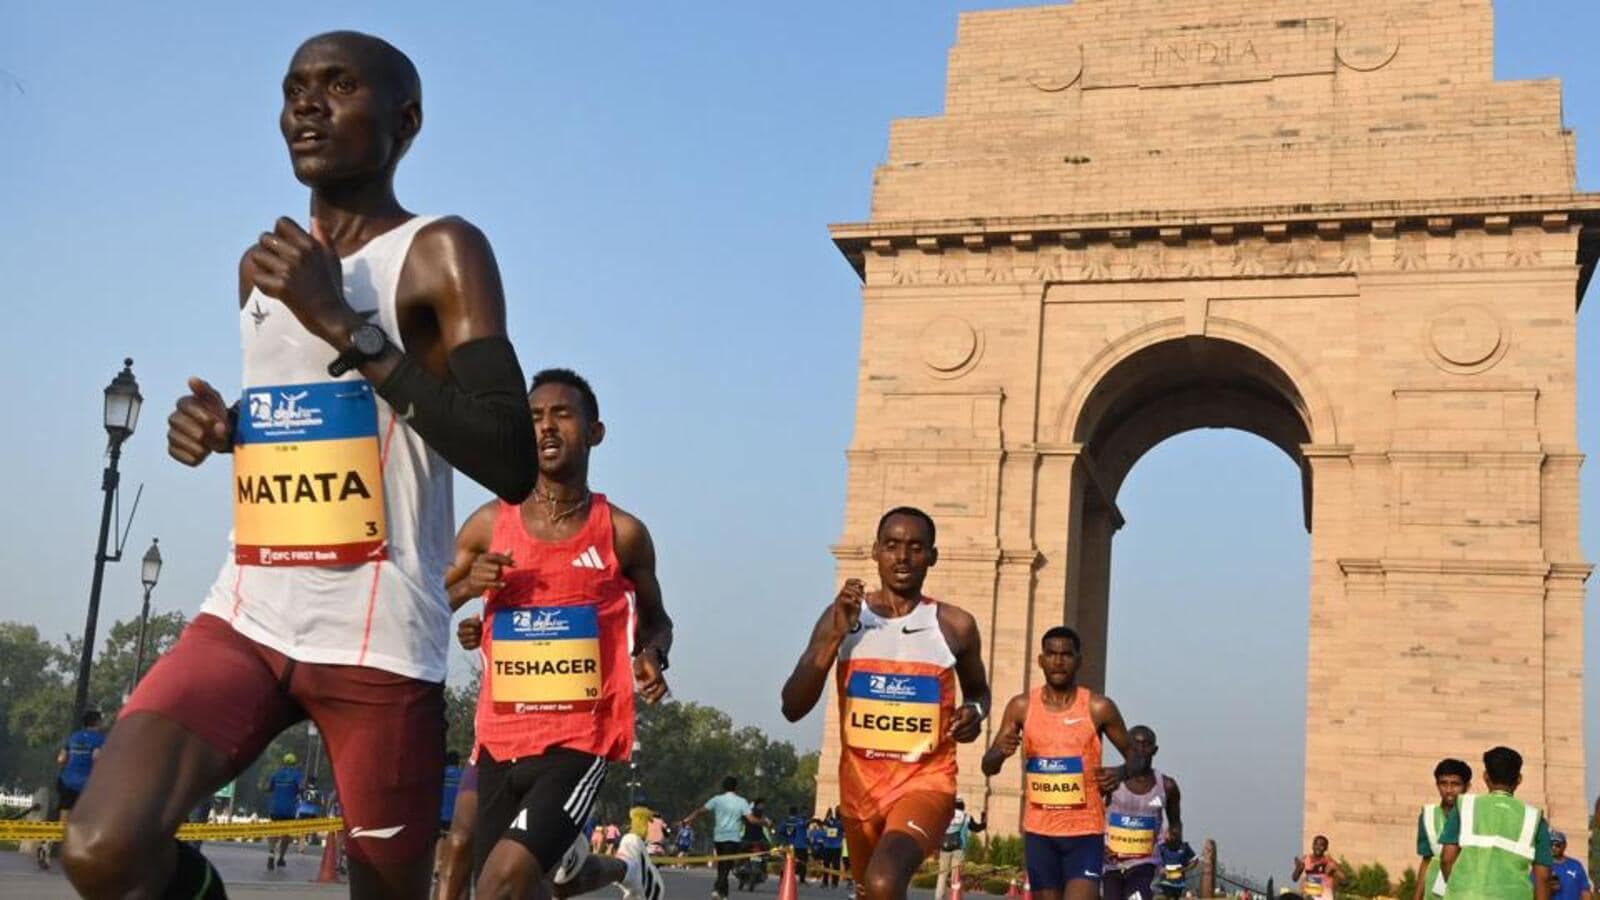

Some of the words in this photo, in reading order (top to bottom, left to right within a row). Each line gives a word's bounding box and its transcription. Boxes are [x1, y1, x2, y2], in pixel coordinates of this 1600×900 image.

[1151, 39, 1263, 69] INDIA
[237, 470, 372, 504] MATATA
[365, 521, 378, 537] 3
[494, 659, 597, 676] TESHAGER
[586, 687, 598, 697] 10
[851, 712, 933, 733] LEGESE
[1031, 782, 1080, 793] DIBABA
